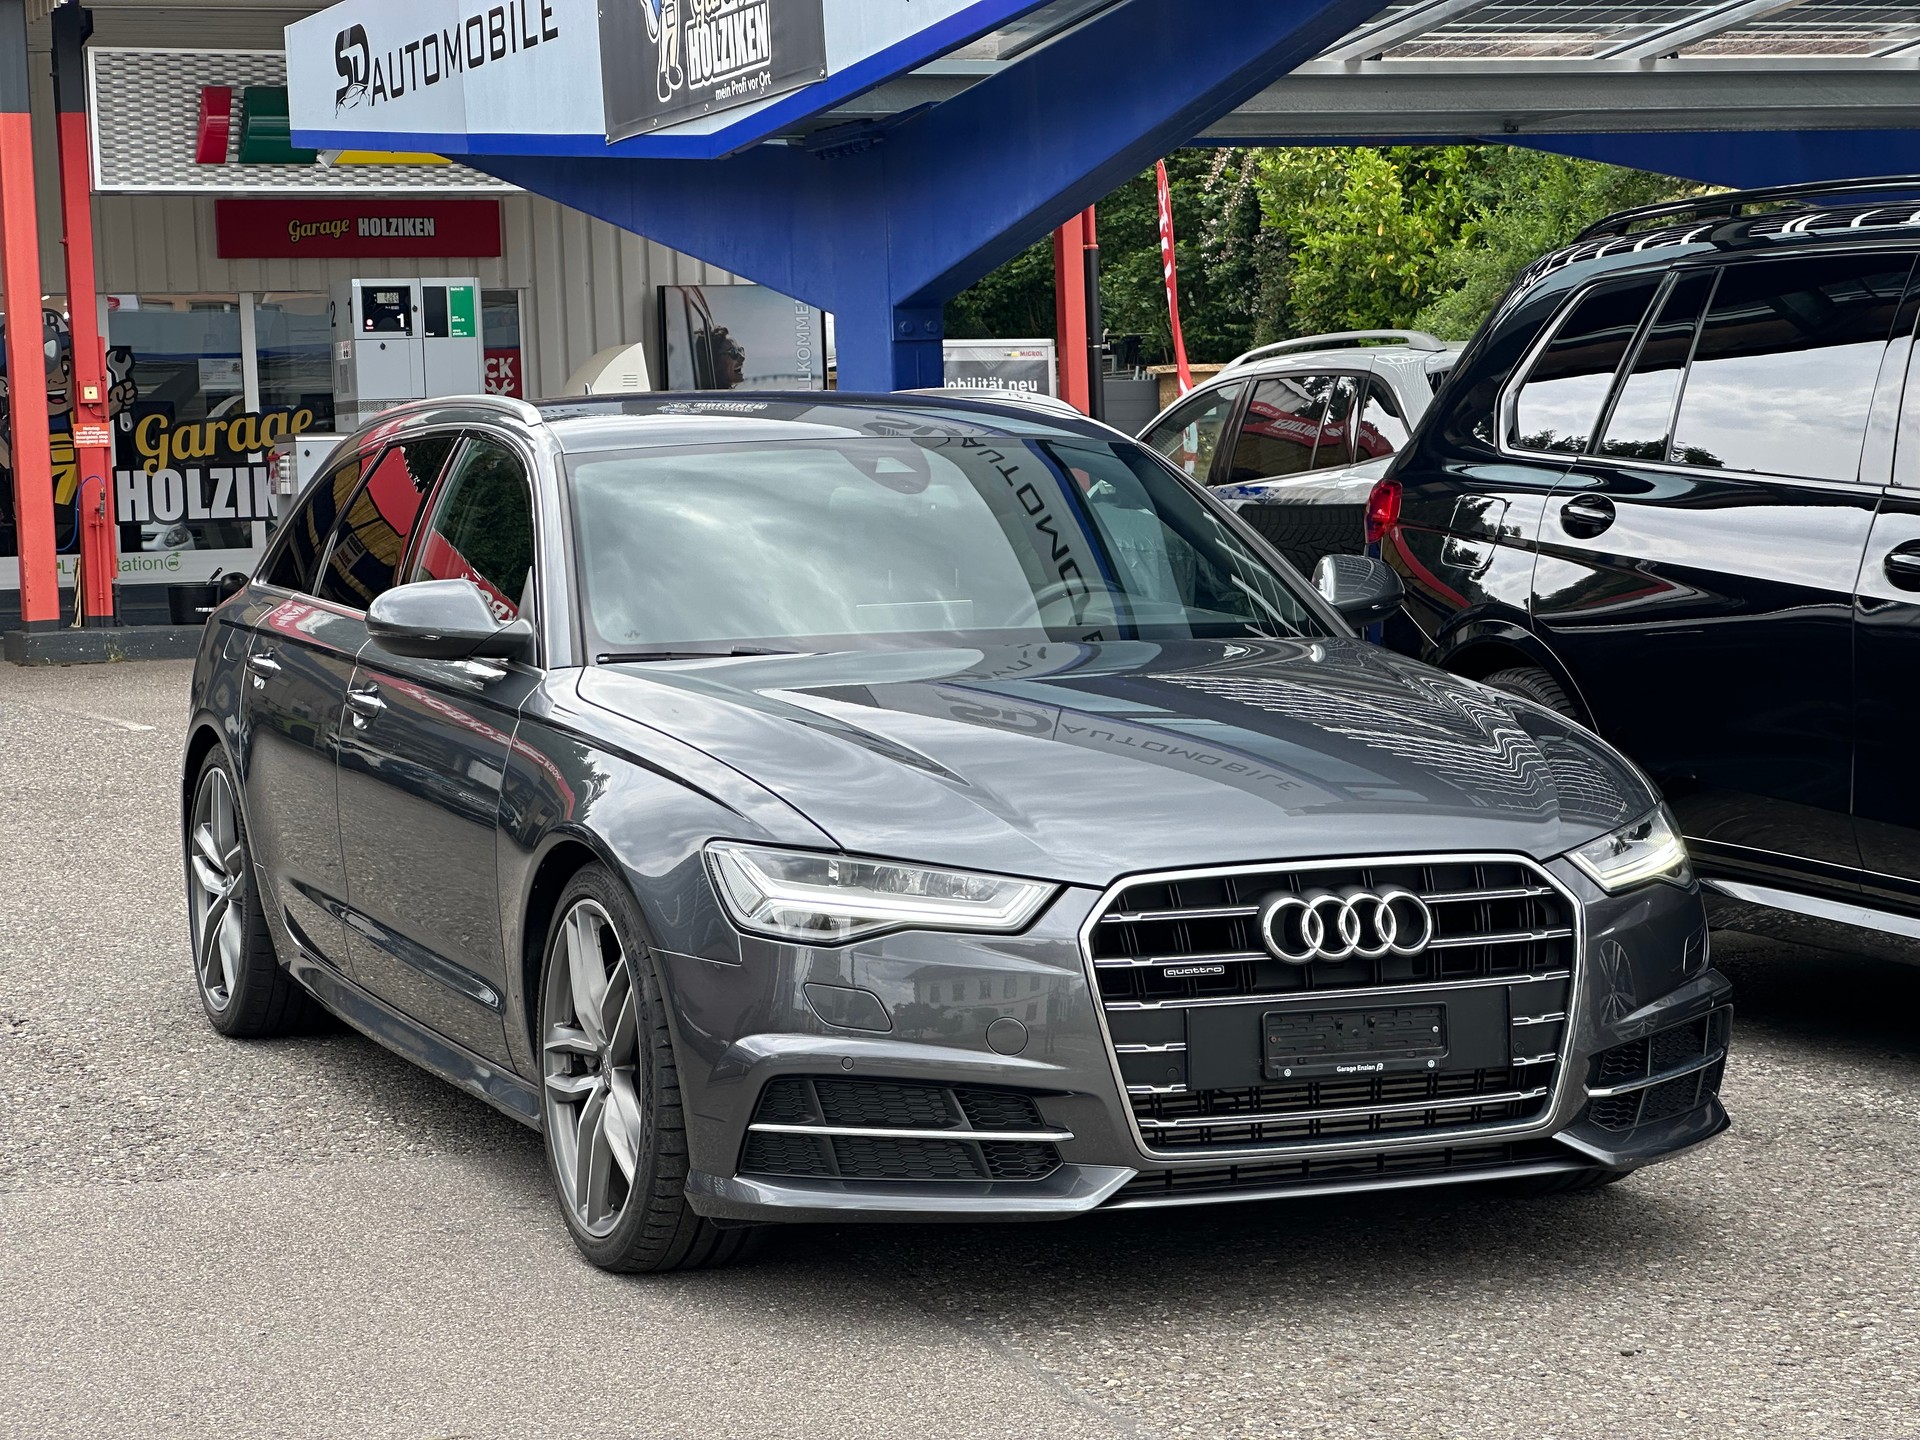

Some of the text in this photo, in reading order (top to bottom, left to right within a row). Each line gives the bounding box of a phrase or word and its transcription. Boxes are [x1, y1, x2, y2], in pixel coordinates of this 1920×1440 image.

[371, 0, 559, 107] AUTOMOBILE
[688, 3, 769, 82] HOLZIKEN
[715, 71, 771, 101] mein Profi vor Ort
[288, 217, 435, 242] Garage HOLZIKEN
[330, 301, 336, 328] 2
[396, 313, 405, 328] 1
[795, 300, 813, 391] LLKOMME
[484, 357, 514, 378] CK
[944, 377, 1038, 392] obilität neu
[135, 408, 313, 477] Garage
[116, 465, 278, 522] HOLZIK
[1166, 967, 1223, 976] quattro
[1336, 1065, 1356, 1073] Garage
